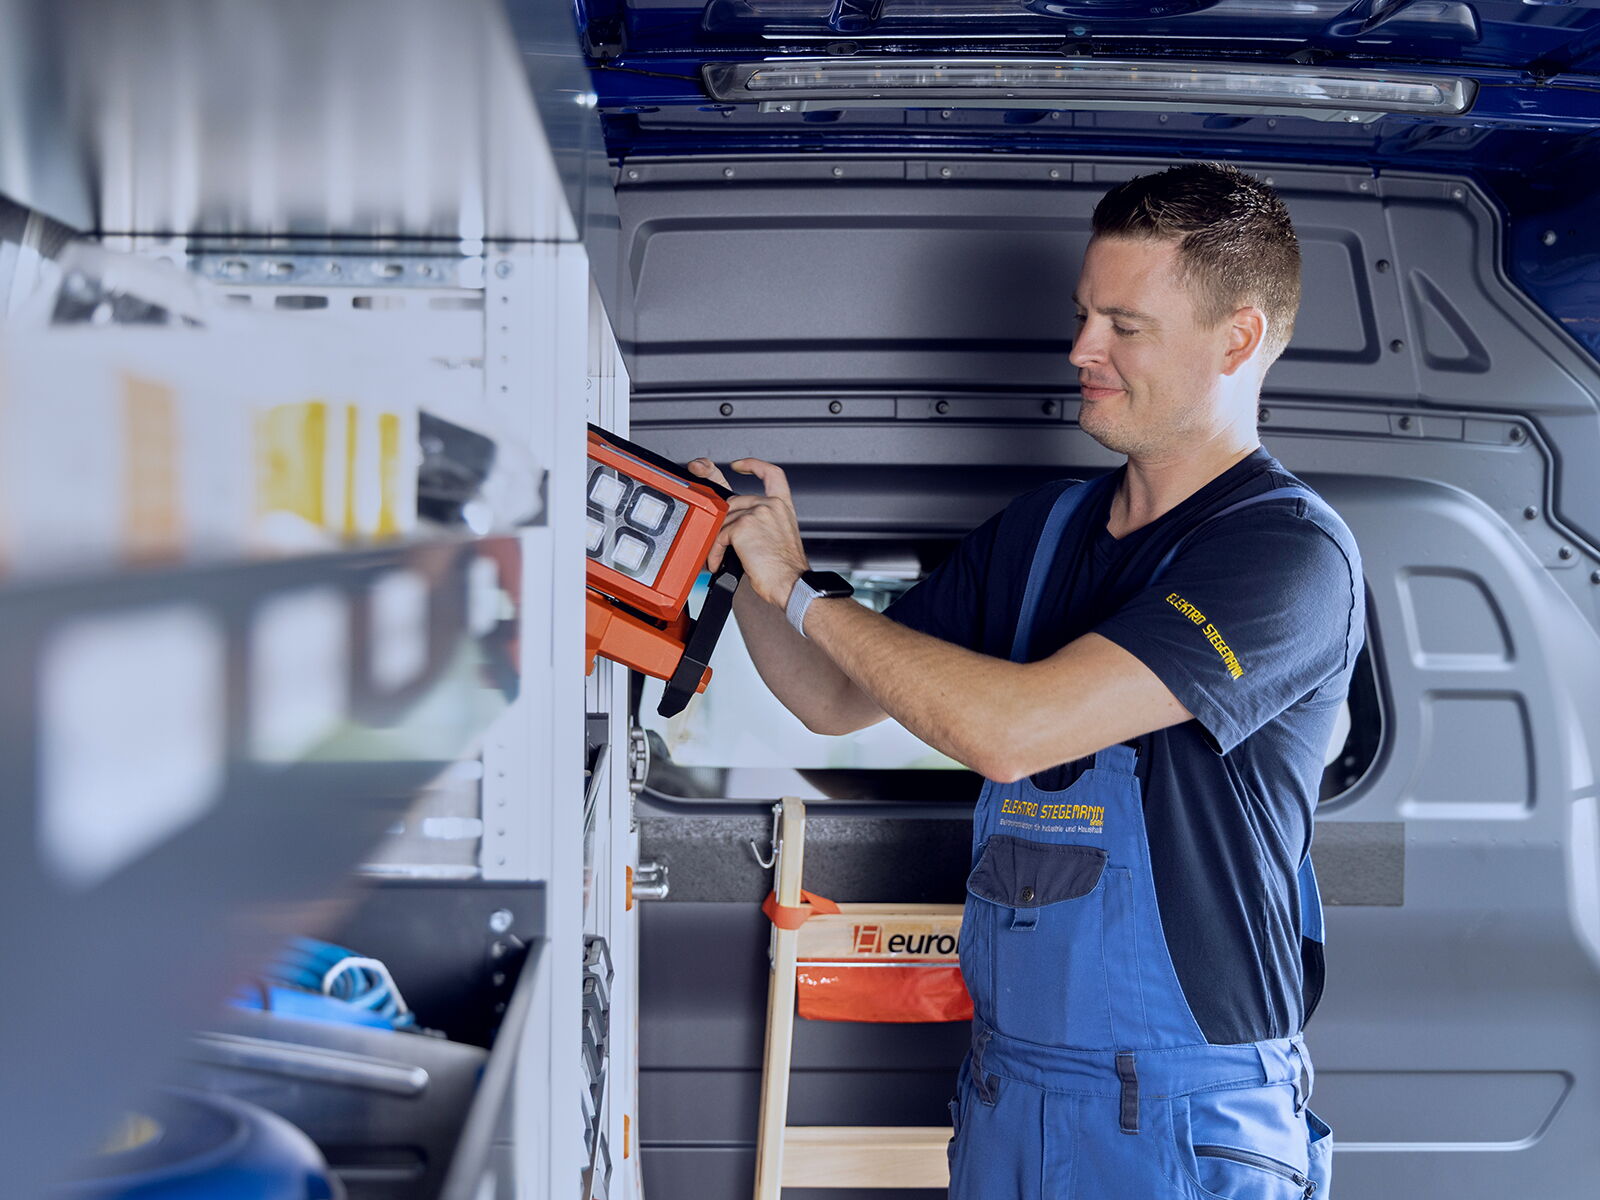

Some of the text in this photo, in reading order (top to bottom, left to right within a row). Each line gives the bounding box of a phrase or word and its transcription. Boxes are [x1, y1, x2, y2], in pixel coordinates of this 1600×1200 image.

[1166, 592, 1244, 680] ELEKTRO STEGEMANN
[1001, 799, 1105, 821] ELEKTRO STEGEMANN
